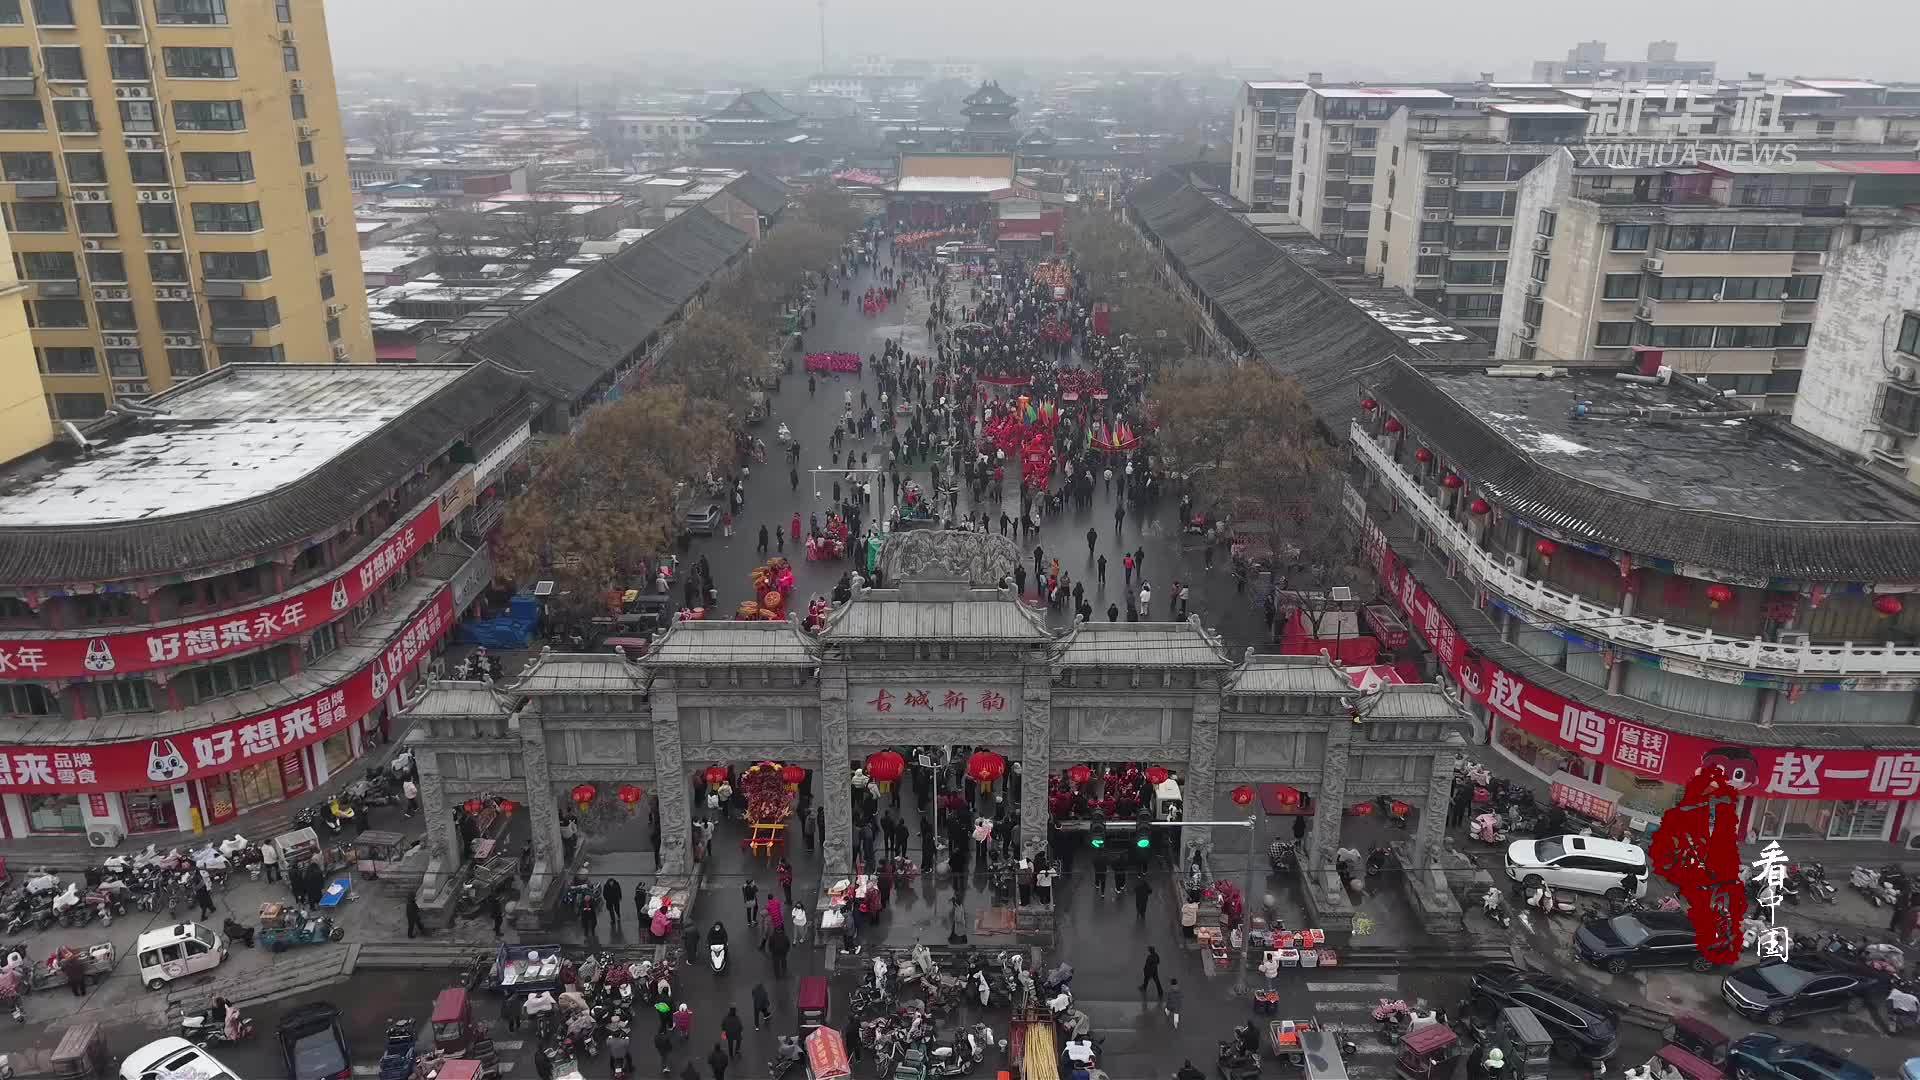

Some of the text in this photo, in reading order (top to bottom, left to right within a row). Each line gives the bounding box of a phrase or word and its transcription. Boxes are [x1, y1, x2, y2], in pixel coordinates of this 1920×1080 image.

[146, 602, 307, 662] 好想来永年
[387, 616, 430, 681] 好想来
[316, 689, 345, 715] 品牌
[866, 687, 1006, 713] 古城新韵
[1487, 669, 1606, 755] 赵一鸣
[318, 706, 347, 729] 零食
[192, 706, 317, 769] 好想来
[1621, 726, 1663, 752] 省钱
[53, 752, 93, 768] 品牌
[1618, 744, 1661, 769] 超市
[56, 768, 97, 785] 零食
[1764, 751, 1920, 796] 赵一鸣
